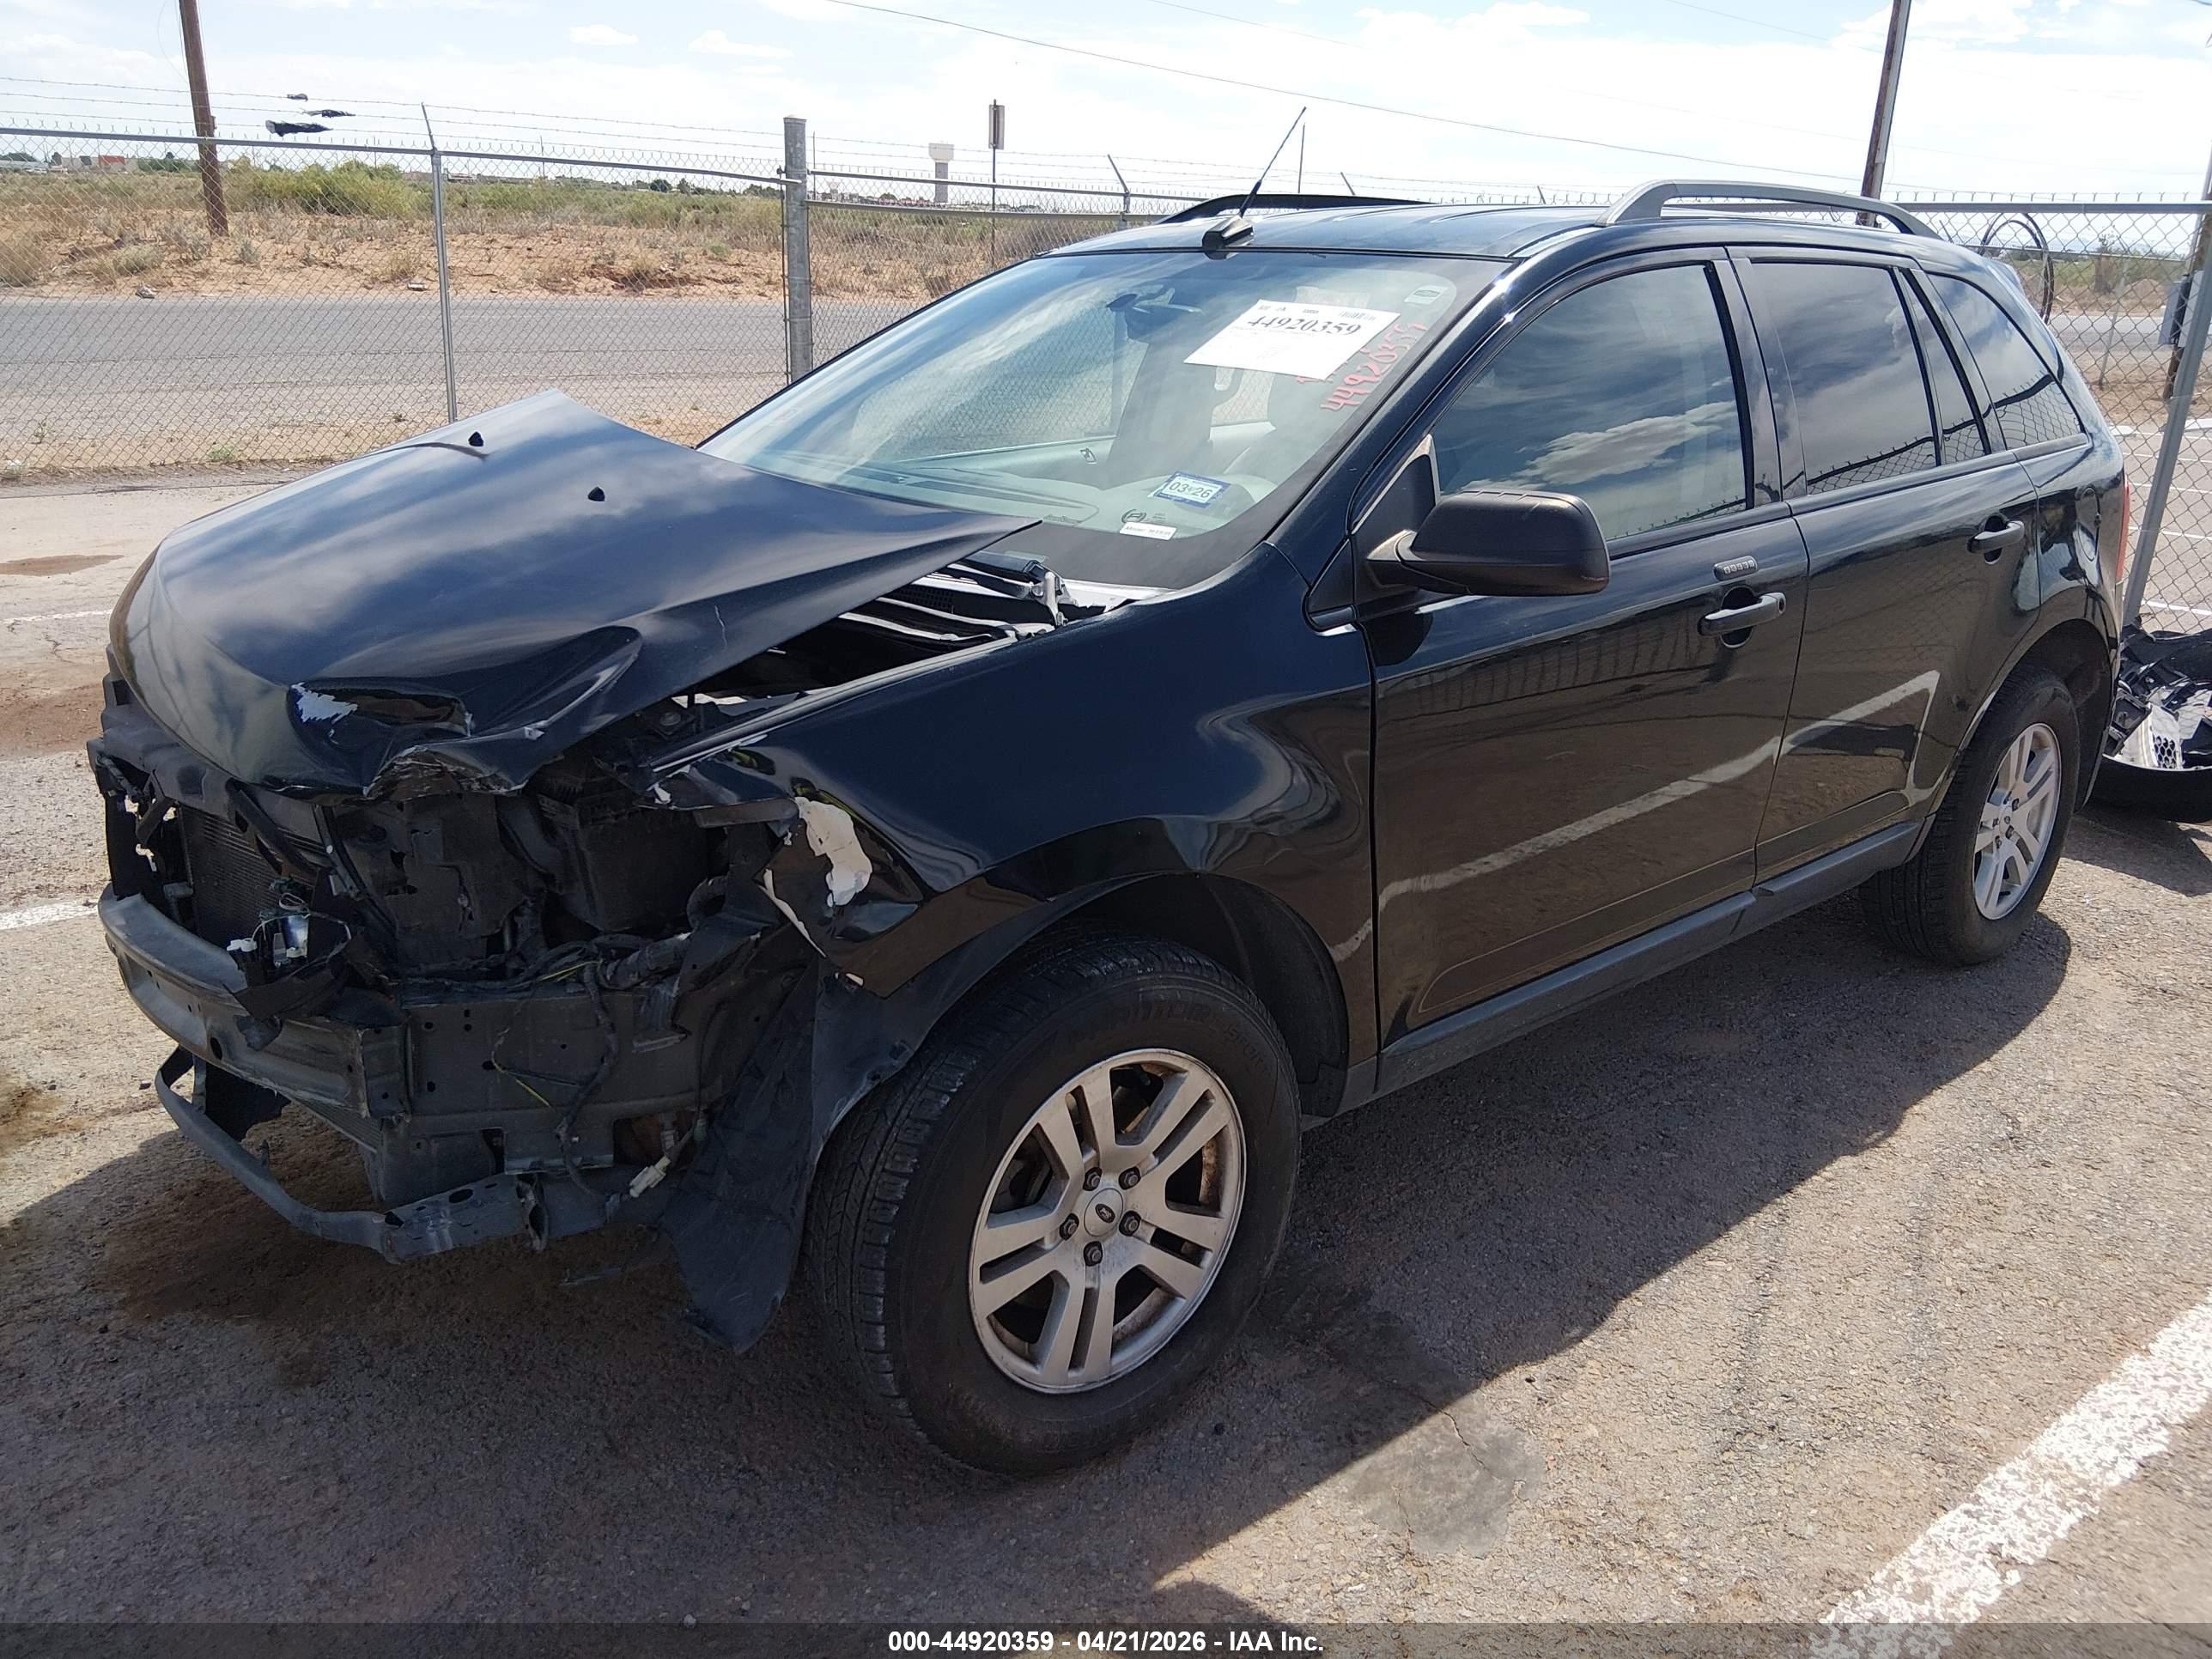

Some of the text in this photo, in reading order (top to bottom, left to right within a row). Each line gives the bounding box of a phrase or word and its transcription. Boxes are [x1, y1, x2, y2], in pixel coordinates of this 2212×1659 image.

[1248, 314, 1362, 336] 44920359
[1169, 482, 1212, 498] 03 26
